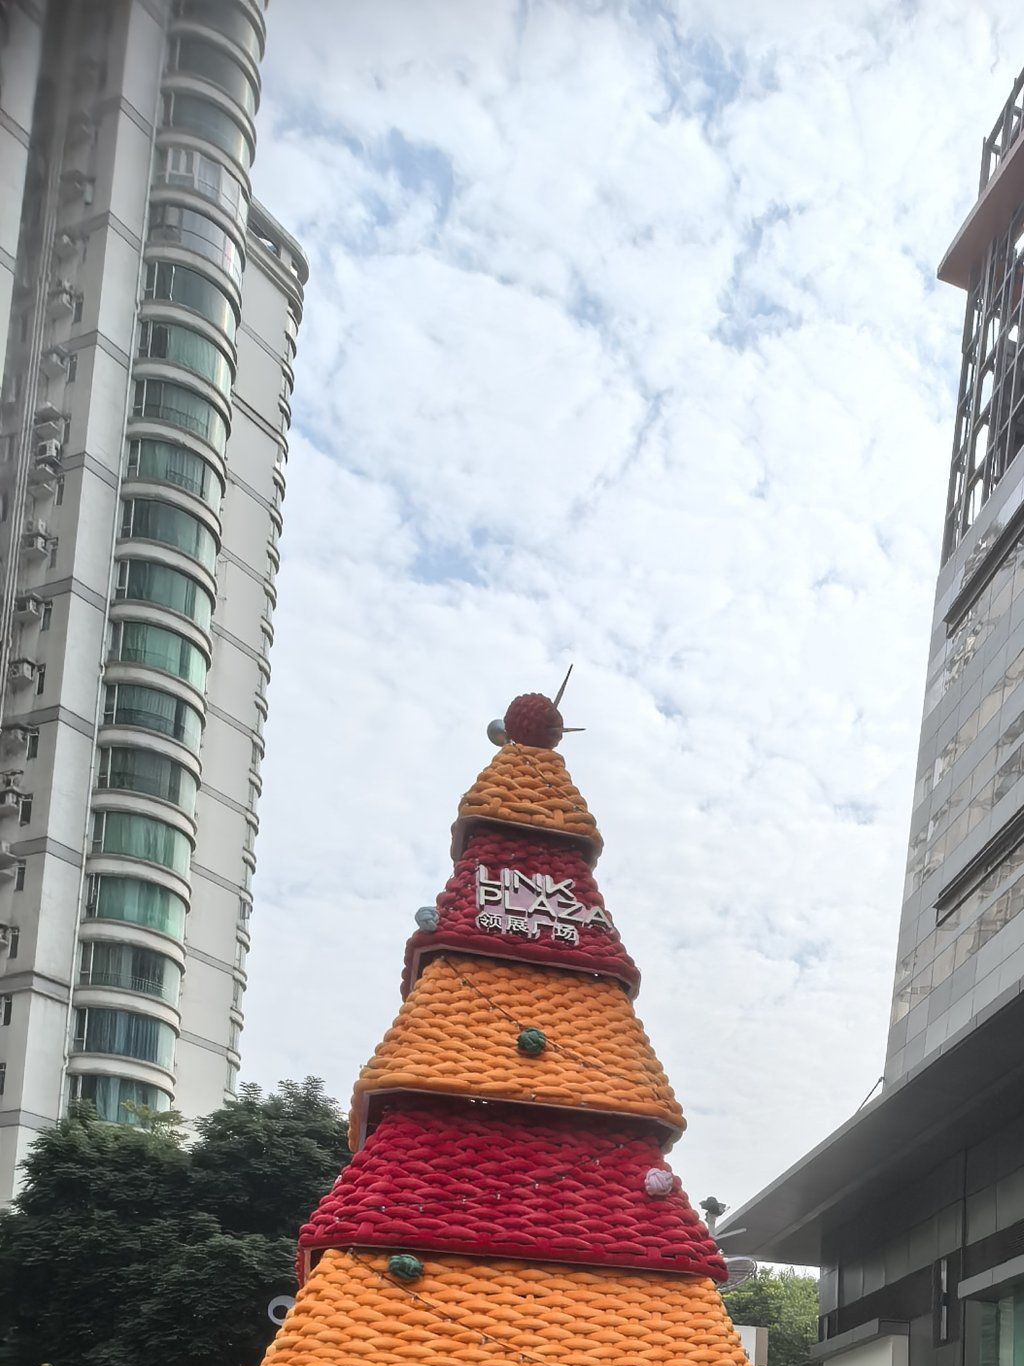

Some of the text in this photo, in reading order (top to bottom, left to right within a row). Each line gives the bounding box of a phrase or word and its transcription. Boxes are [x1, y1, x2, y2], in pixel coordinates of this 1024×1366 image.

[476, 864, 576, 900] LINK
[477, 886, 614, 930] PLAZA
[476, 911, 579, 946] 领展广场
